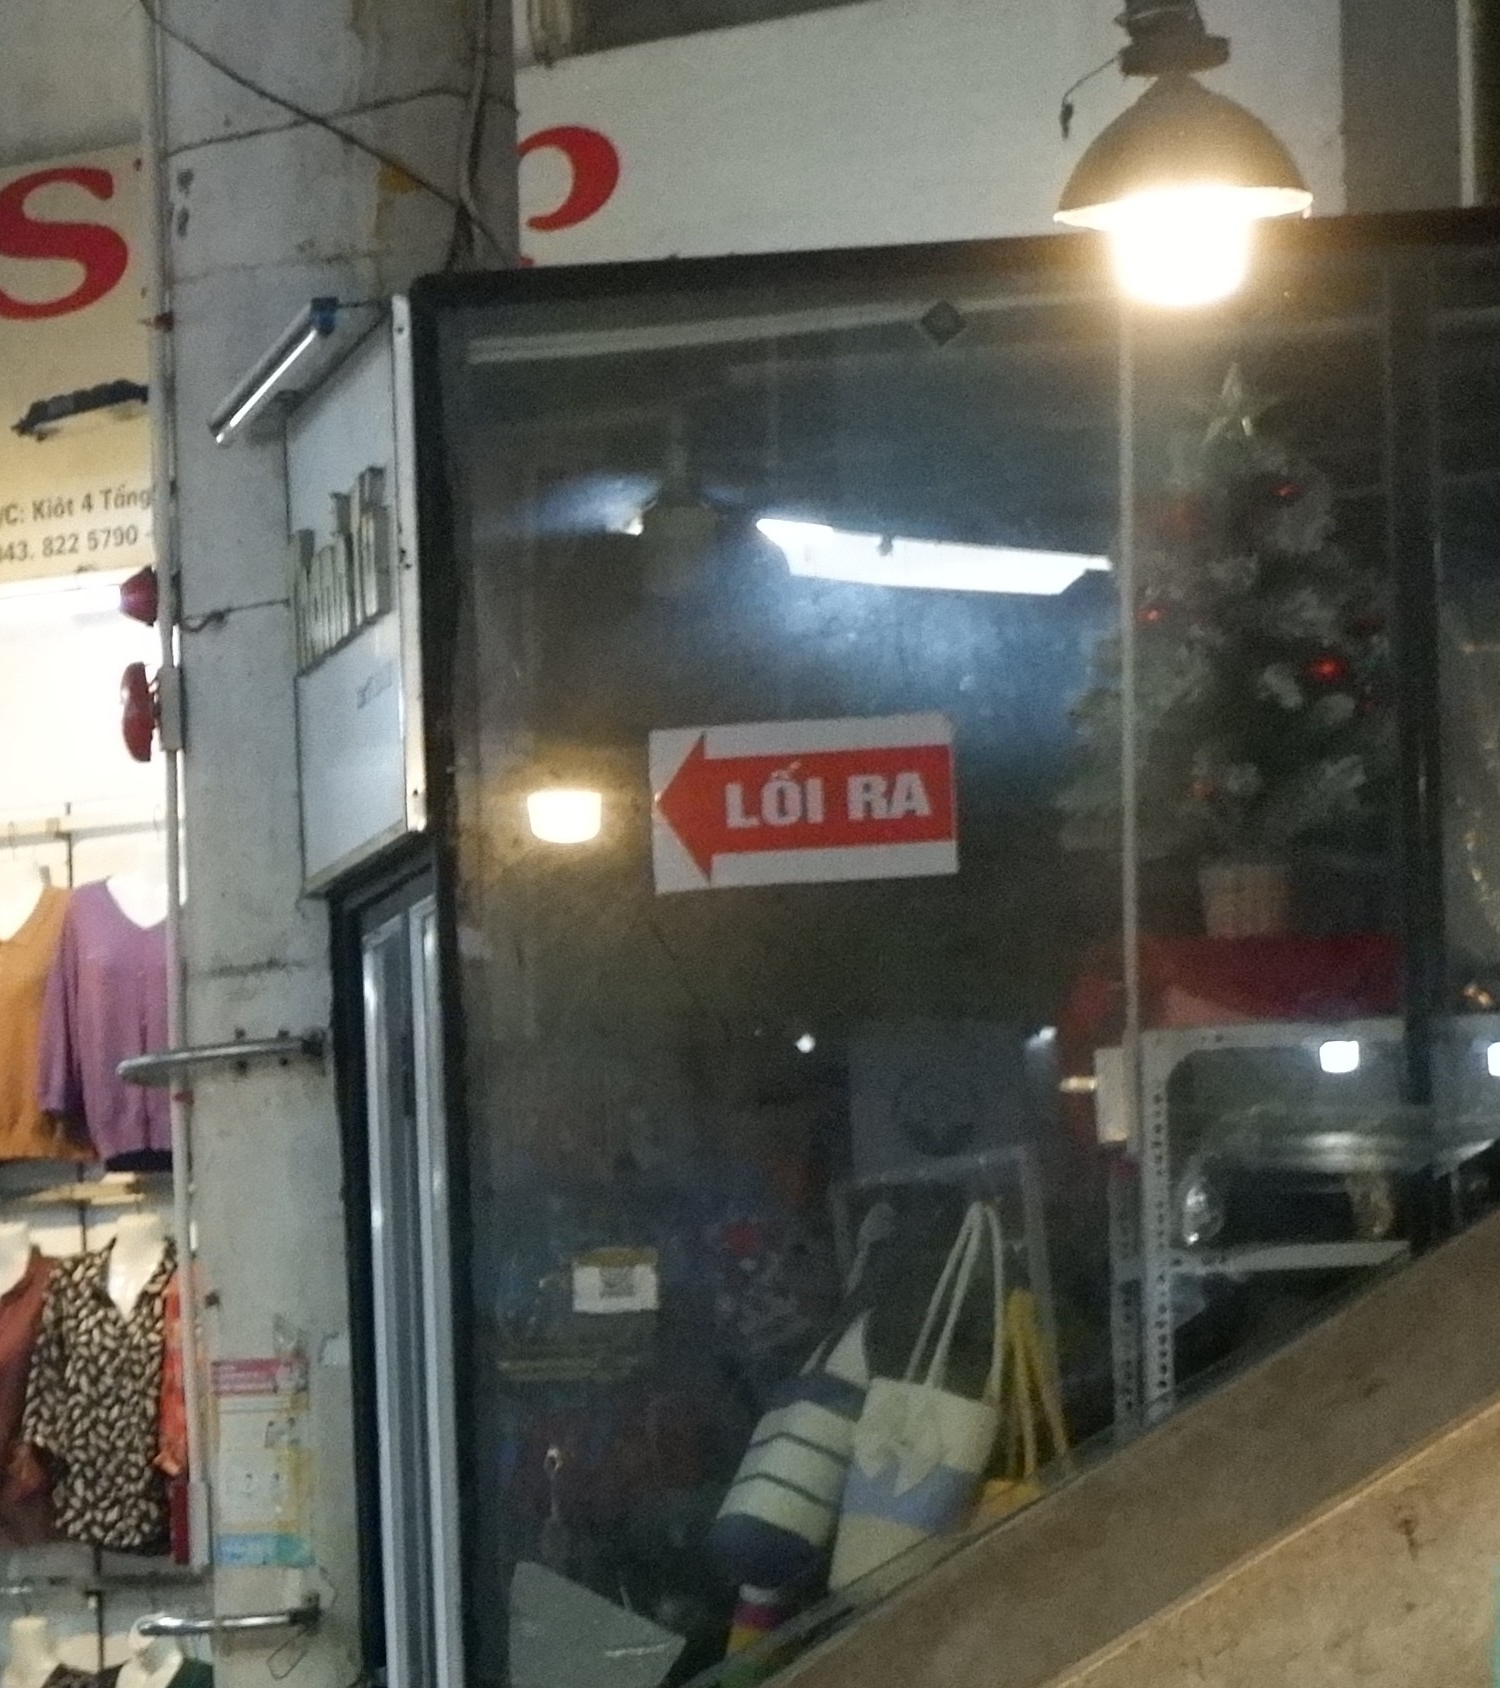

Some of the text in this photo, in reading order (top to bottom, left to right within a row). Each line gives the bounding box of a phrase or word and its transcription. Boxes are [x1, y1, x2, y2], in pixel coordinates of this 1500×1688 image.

[81, 492, 94, 513] 4
[42, 532, 80, 558] 822
[87, 524, 139, 551] 5790
[725, 760, 932, 829] LỐI RA
